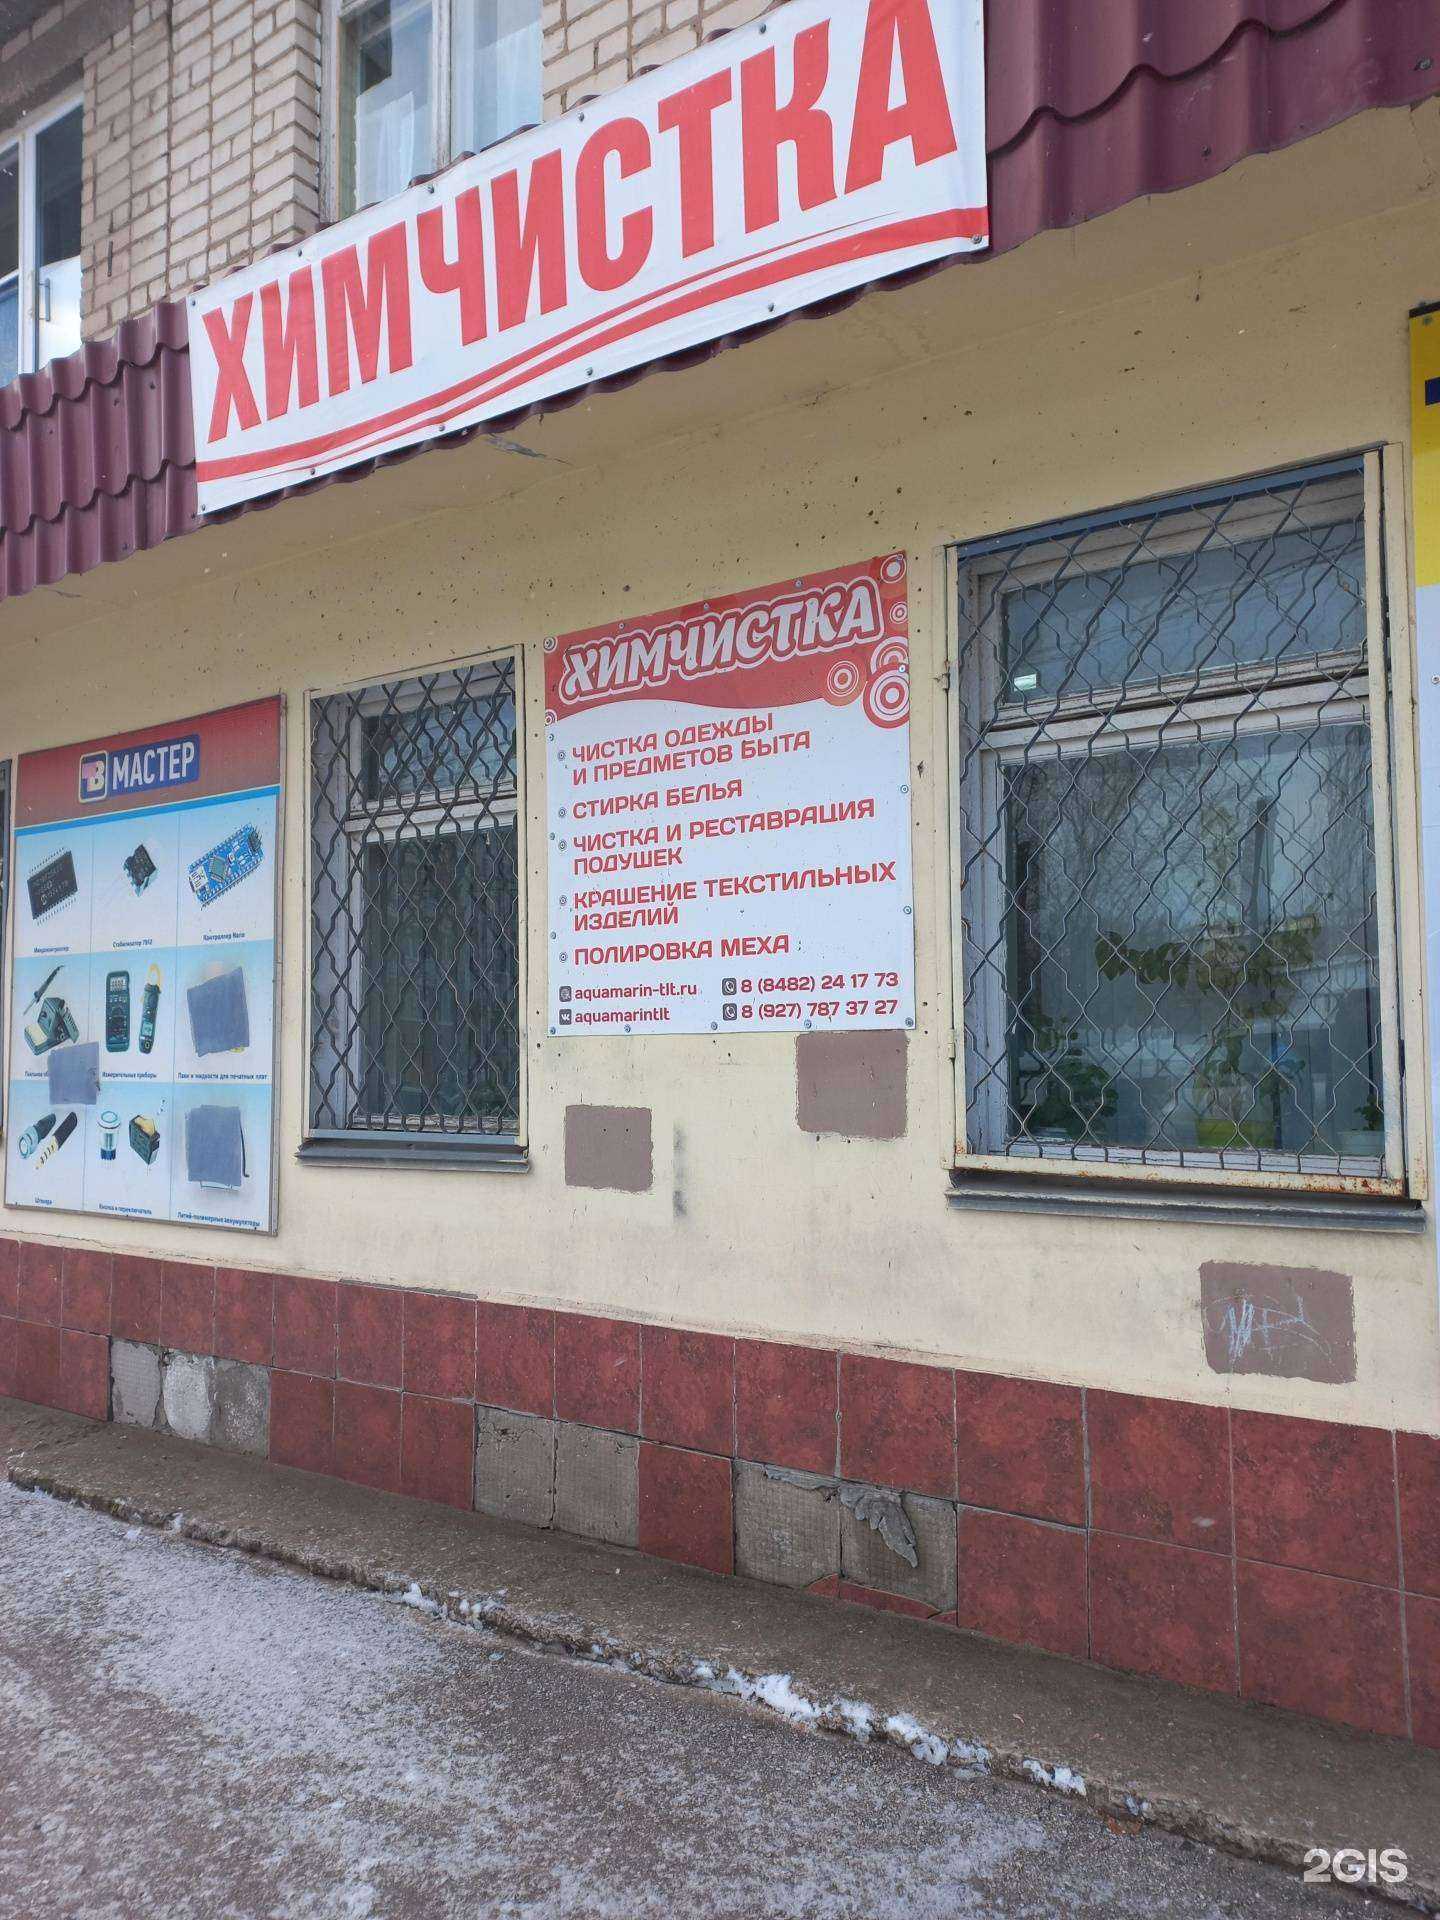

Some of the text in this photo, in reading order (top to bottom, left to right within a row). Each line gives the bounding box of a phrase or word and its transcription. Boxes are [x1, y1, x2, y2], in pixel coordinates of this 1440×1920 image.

[203, 0, 957, 443] ХИМЧИСТКА
[561, 582, 878, 698] ХИМЧИСТКА
[572, 713, 773, 764] ЧИСТКА ОДЕЖДЫ
[573, 731, 811, 786] И ПРЕДМЕТОВ БЫТА
[112, 741, 195, 790] МАСТЕР
[572, 779, 743, 819] СТИРКА БЕЛЬЯ
[573, 798, 875, 853] ЧИСТКА И РЕСТАВРАЦИЯ
[574, 847, 683, 876] ПОДУШЕК
[574, 861, 897, 909] КРАШЕНИЕ ТЕКСТИЛЬНЫХ
[574, 902, 679, 931] ИЗДЕЛИЙ
[575, 934, 790, 966] ПОЛИРОВКА МЕХА
[574, 982, 698, 1002] aquamarin-tlt.ru
[741, 971, 899, 995] 8 (8482) 24 17 73
[574, 1007, 670, 1024] aquamarintlt
[741, 1000, 898, 1020] 8 (927) 787 37 27
